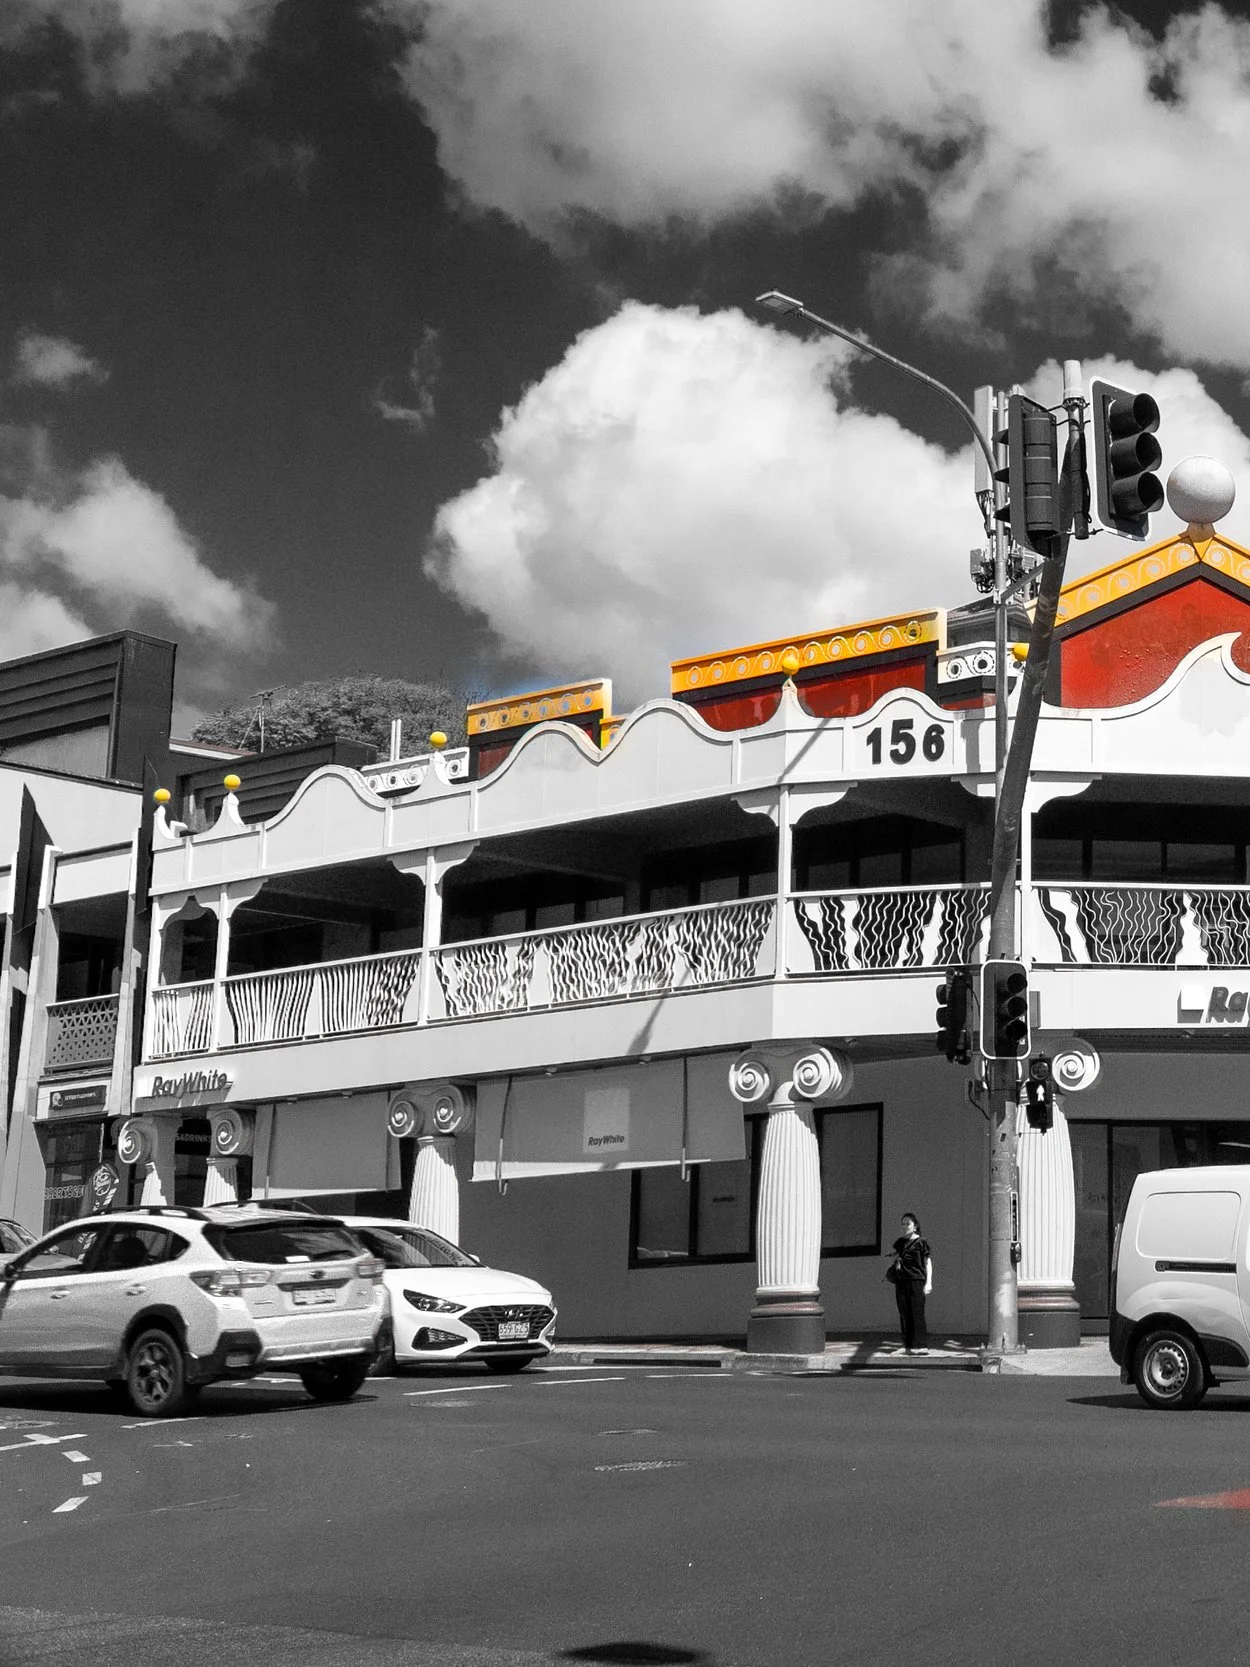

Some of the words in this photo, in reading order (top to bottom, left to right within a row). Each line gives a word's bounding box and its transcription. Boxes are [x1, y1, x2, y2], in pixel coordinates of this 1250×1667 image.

[866, 718, 945, 765] 156
[152, 1070, 227, 1098] RayWhite
[588, 1134, 625, 1146] RayWhite
